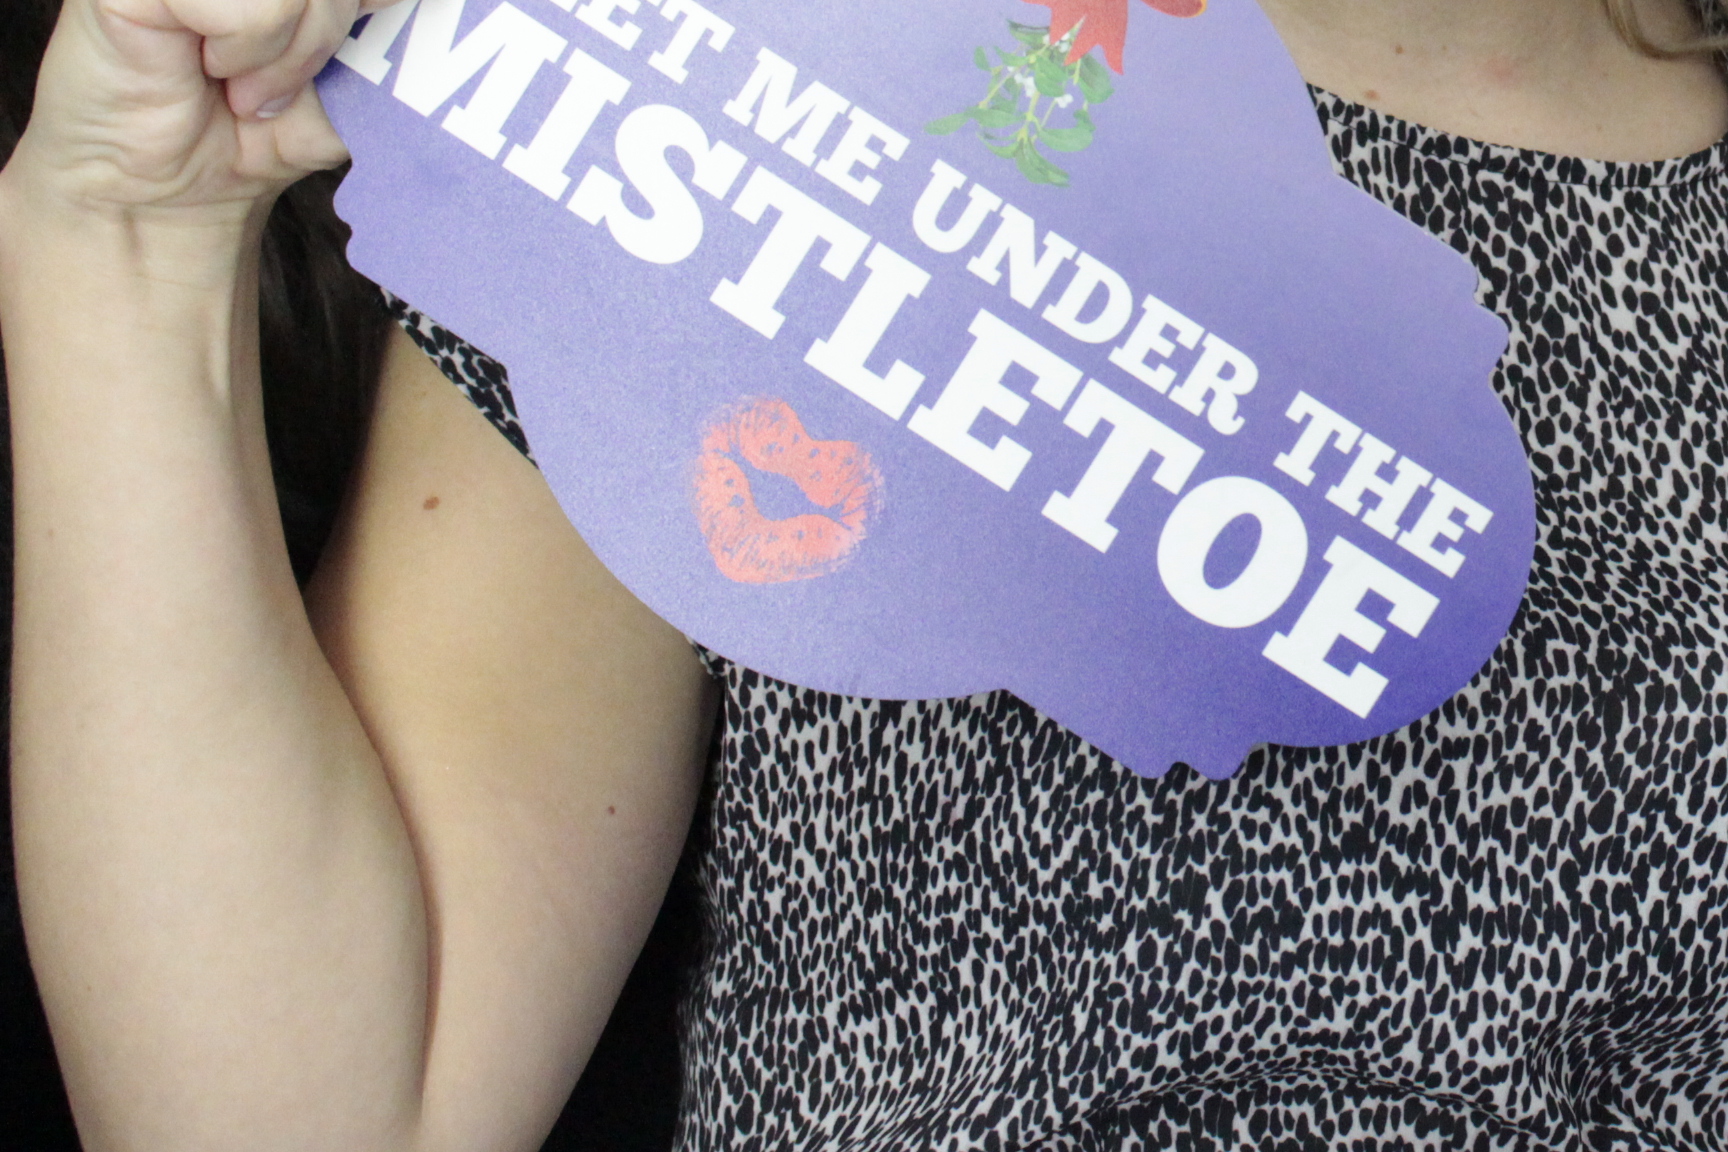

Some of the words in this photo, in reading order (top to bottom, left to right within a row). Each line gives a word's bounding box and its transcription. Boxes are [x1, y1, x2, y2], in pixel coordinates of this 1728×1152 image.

[722, 46, 911, 206] ME
[911, 158, 1259, 436] UNDER
[1273, 389, 1494, 578] THE
